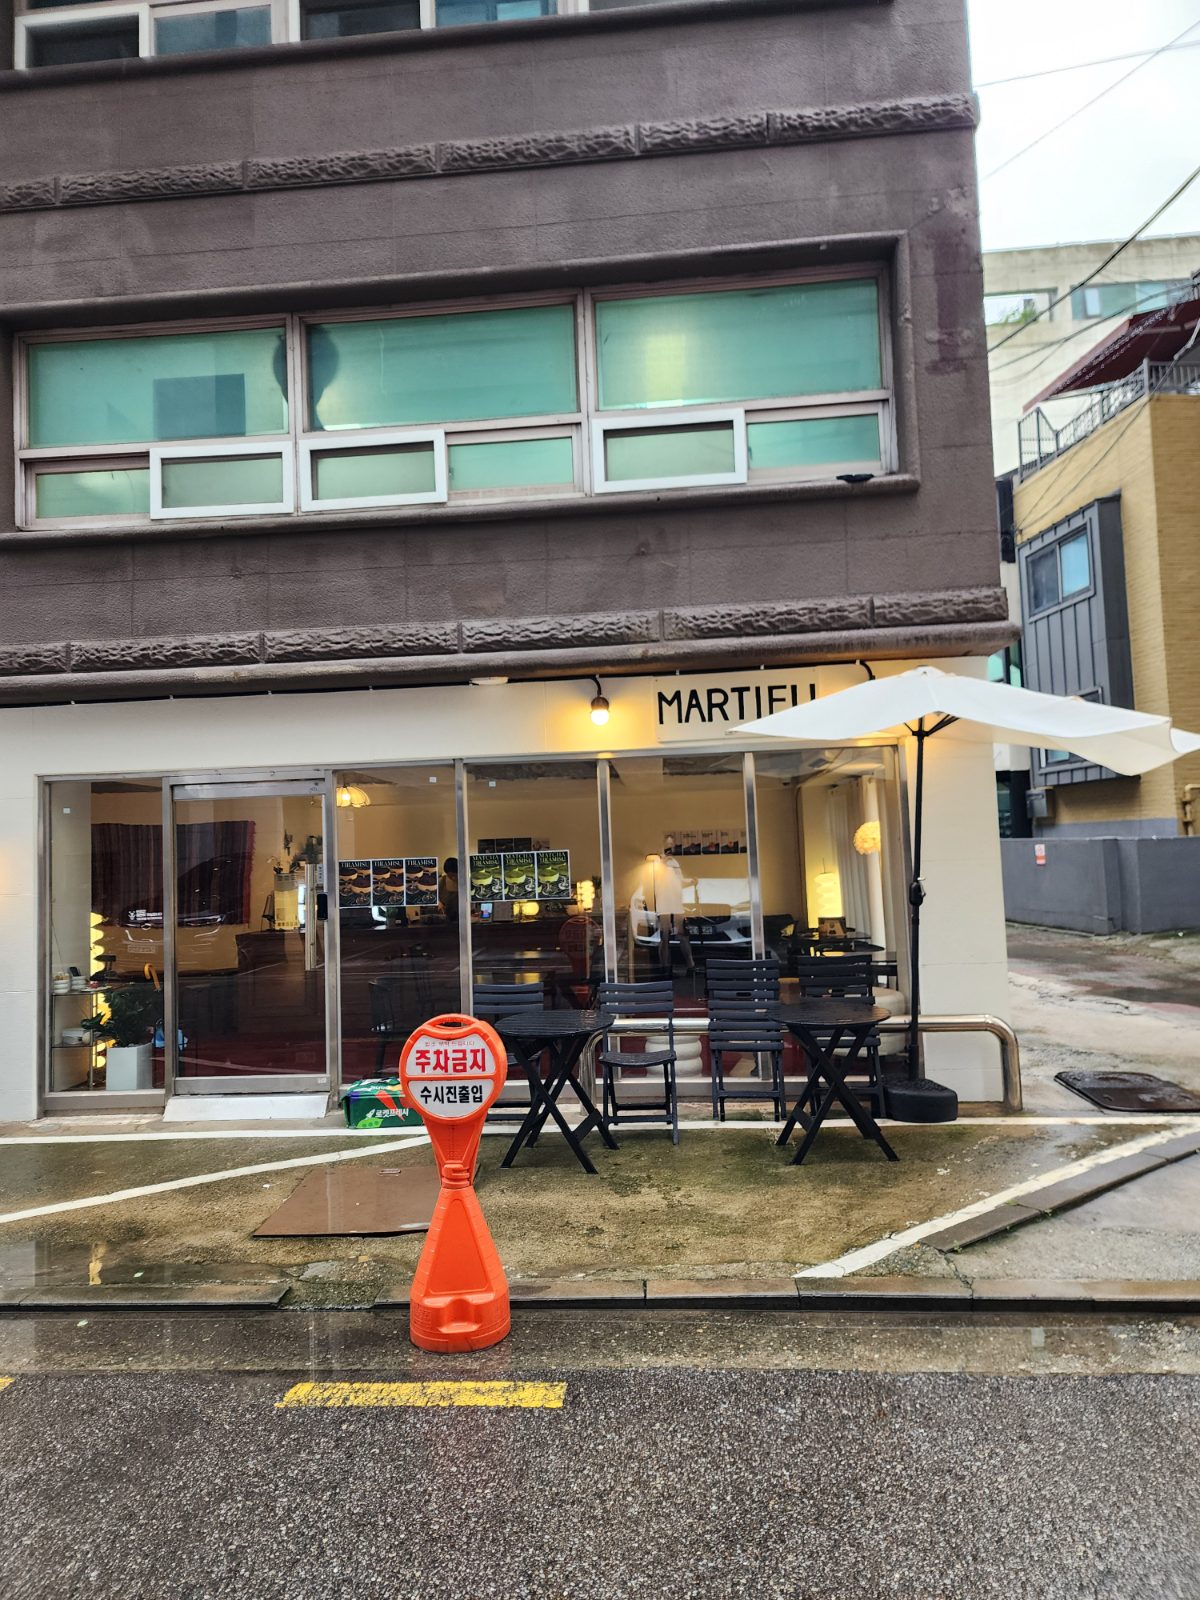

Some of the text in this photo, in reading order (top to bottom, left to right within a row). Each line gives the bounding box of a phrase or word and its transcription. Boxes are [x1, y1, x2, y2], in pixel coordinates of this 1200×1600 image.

[415, 1048, 486, 1073] 주차금지
[420, 1085, 483, 1104] 수시진출입
[375, 1108, 409, 1118] 로켓프레시
